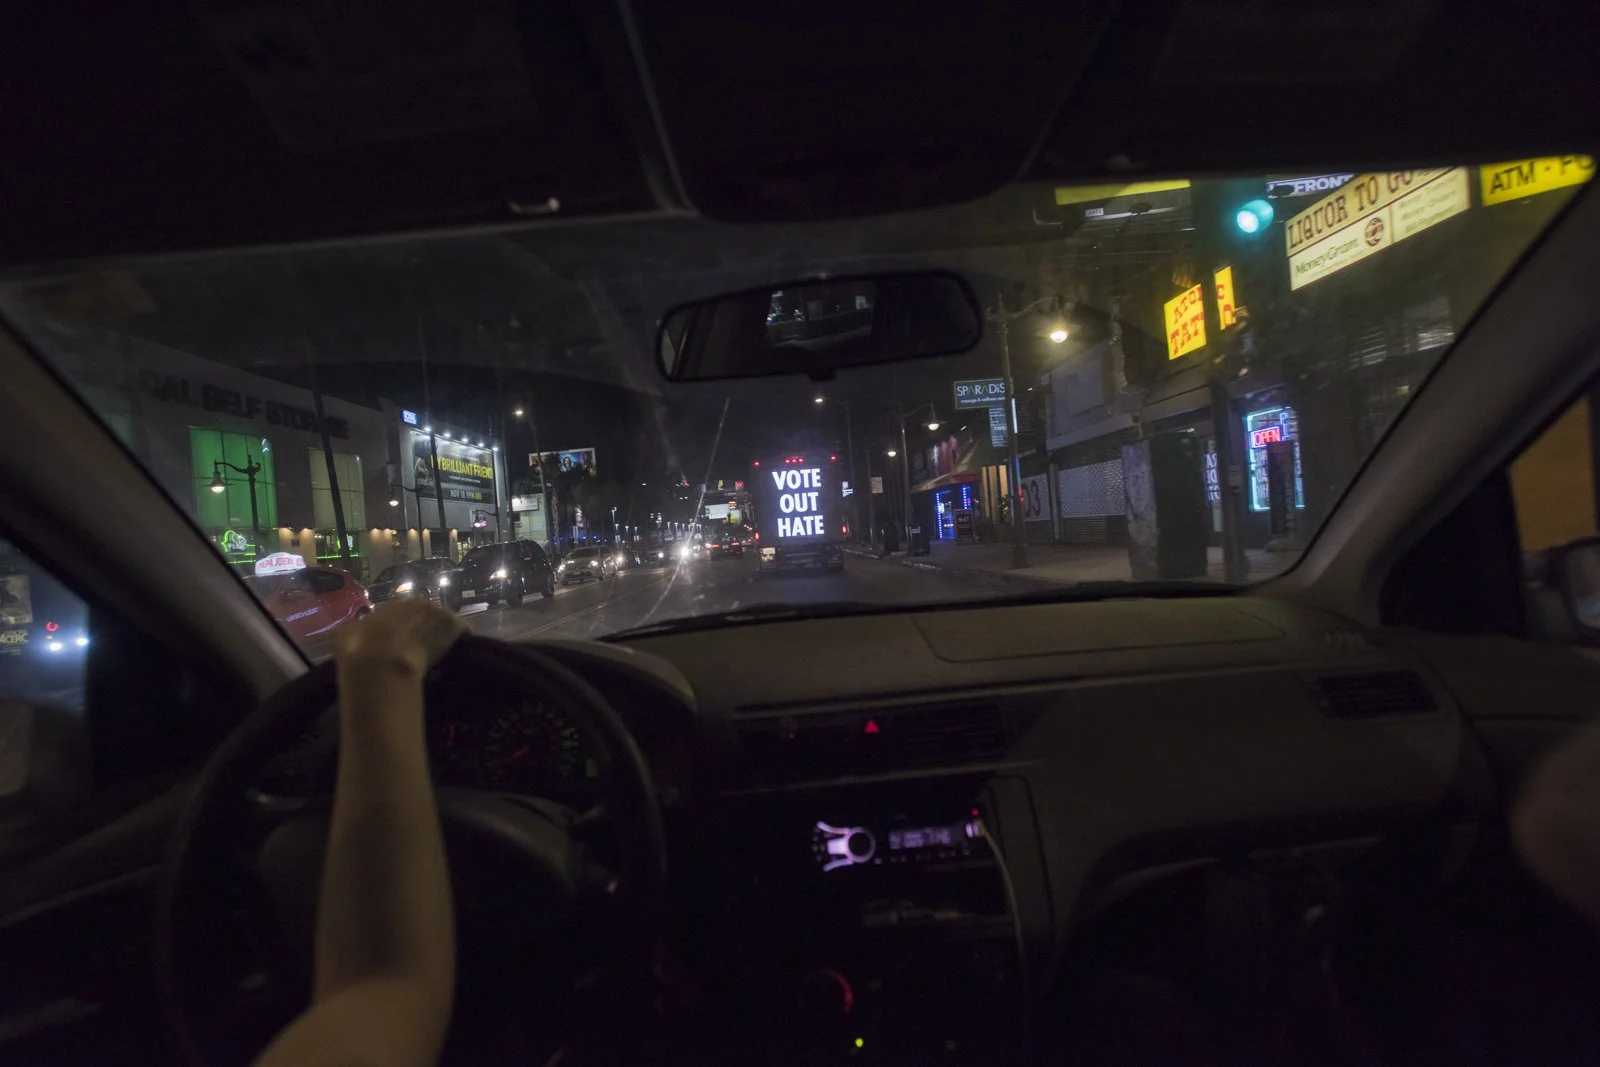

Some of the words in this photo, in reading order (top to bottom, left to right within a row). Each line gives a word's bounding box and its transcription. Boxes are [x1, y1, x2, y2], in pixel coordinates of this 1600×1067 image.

[1489, 160, 1536, 195] ATM
[1288, 195, 1348, 249] LIQUOR
[1355, 176, 1379, 212] TO
[1253, 428, 1280, 446] OPEN
[442, 457, 473, 476] BRILLIANT
[474, 464, 493, 479] FRIEND
[772, 468, 821, 490] VOTE
[780, 492, 818, 513] OUT
[777, 515, 824, 537] HATE
